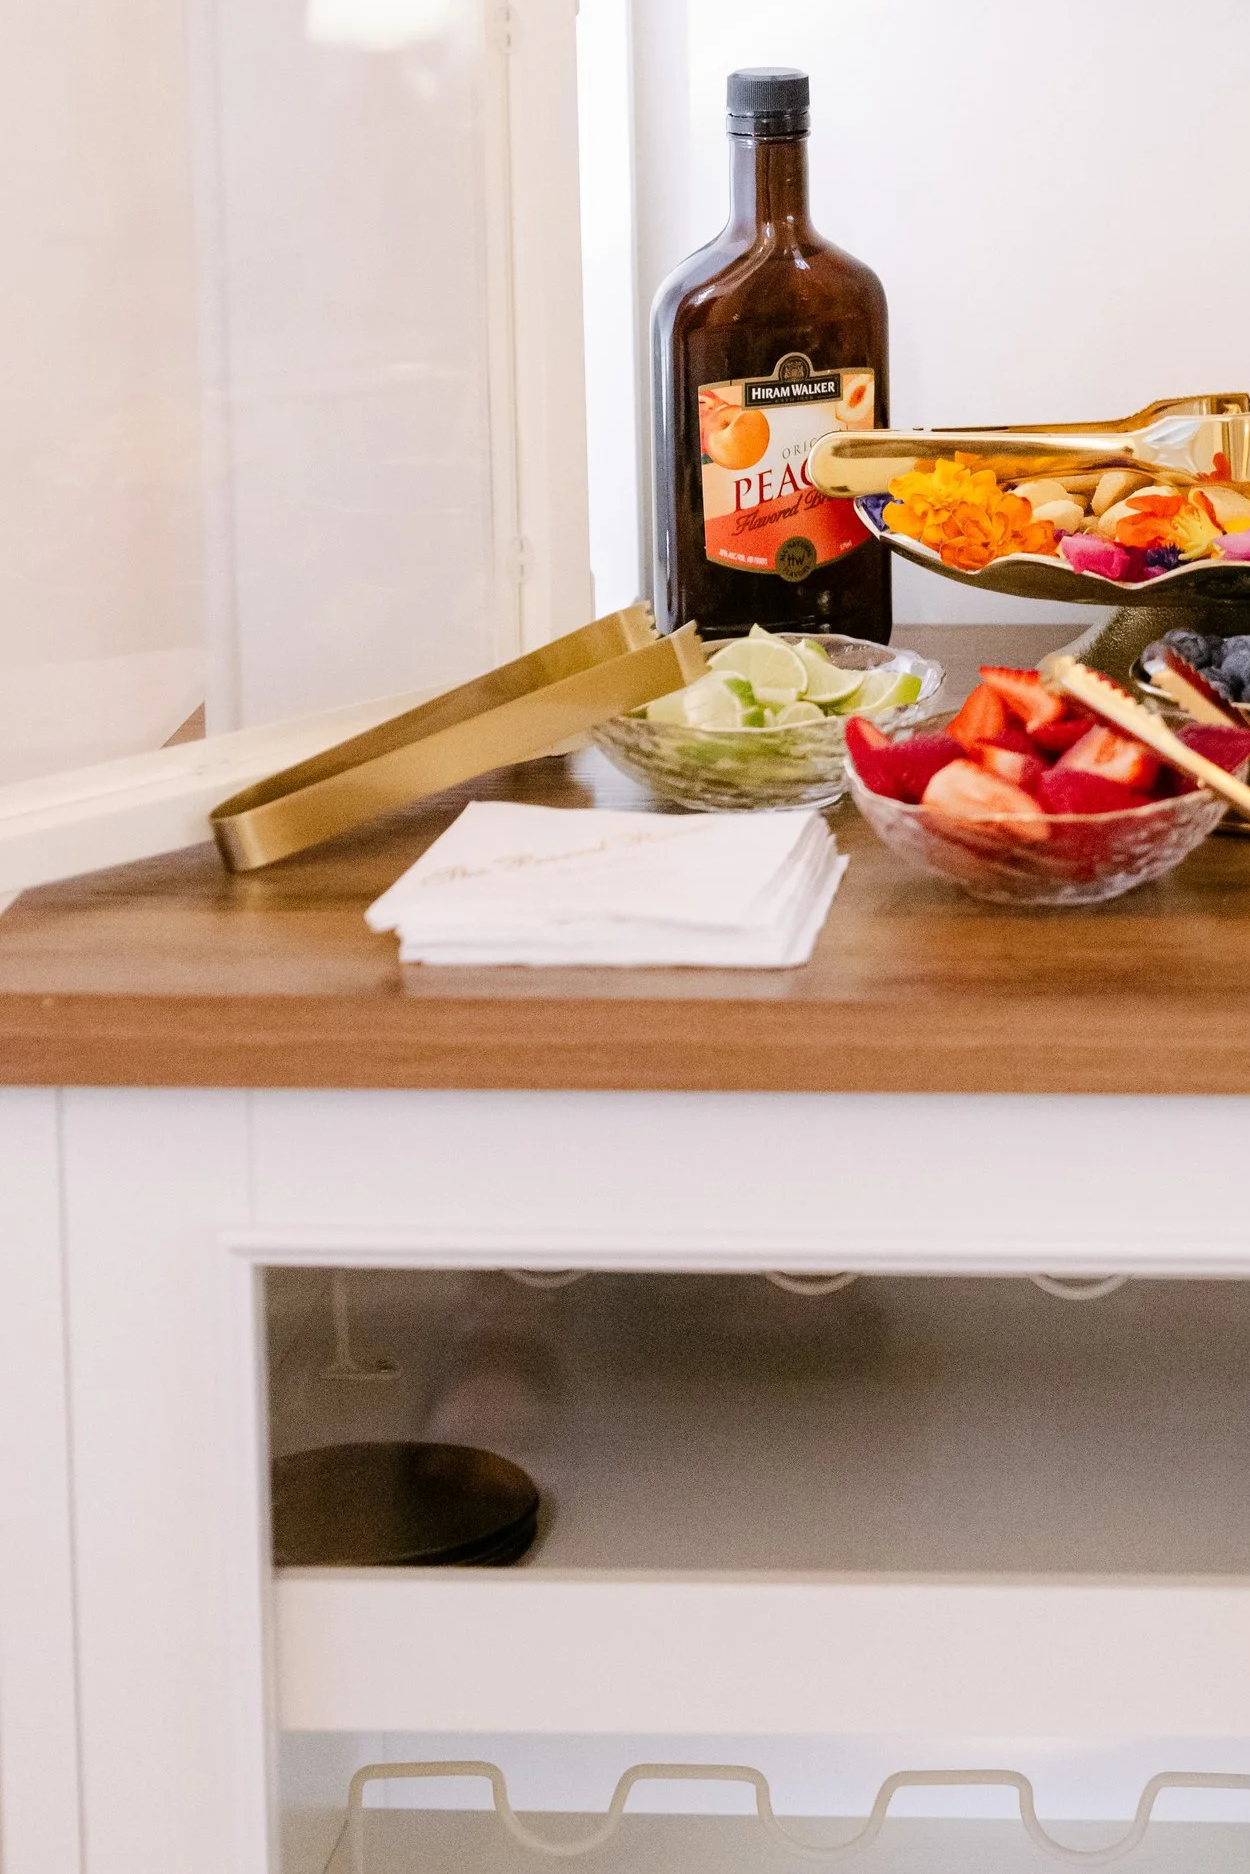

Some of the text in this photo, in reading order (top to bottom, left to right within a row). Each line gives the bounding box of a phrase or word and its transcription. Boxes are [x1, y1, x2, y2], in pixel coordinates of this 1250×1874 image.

[751, 385, 790, 400] HIRAM
[791, 381, 835, 397] WALKER
[731, 493, 803, 536] Flavored
